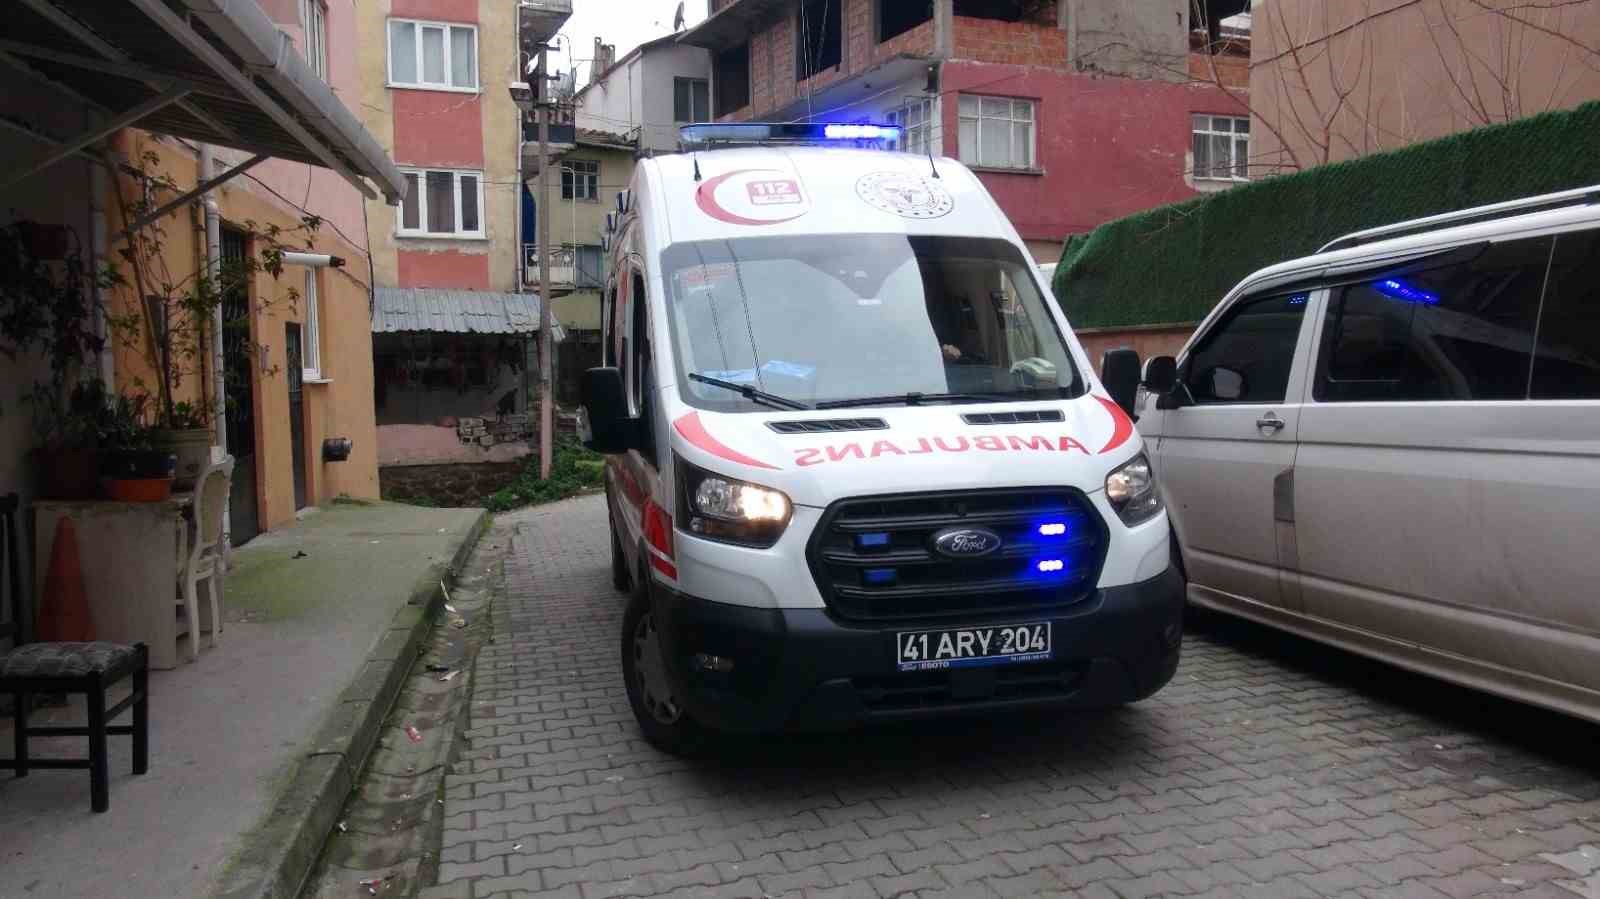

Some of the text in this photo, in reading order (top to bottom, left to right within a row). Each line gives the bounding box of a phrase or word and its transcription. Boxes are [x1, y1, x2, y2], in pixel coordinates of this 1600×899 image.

[752, 181, 791, 195] 112
[951, 534, 987, 551] Ford
[903, 626, 1045, 659] 41 ARY 204
